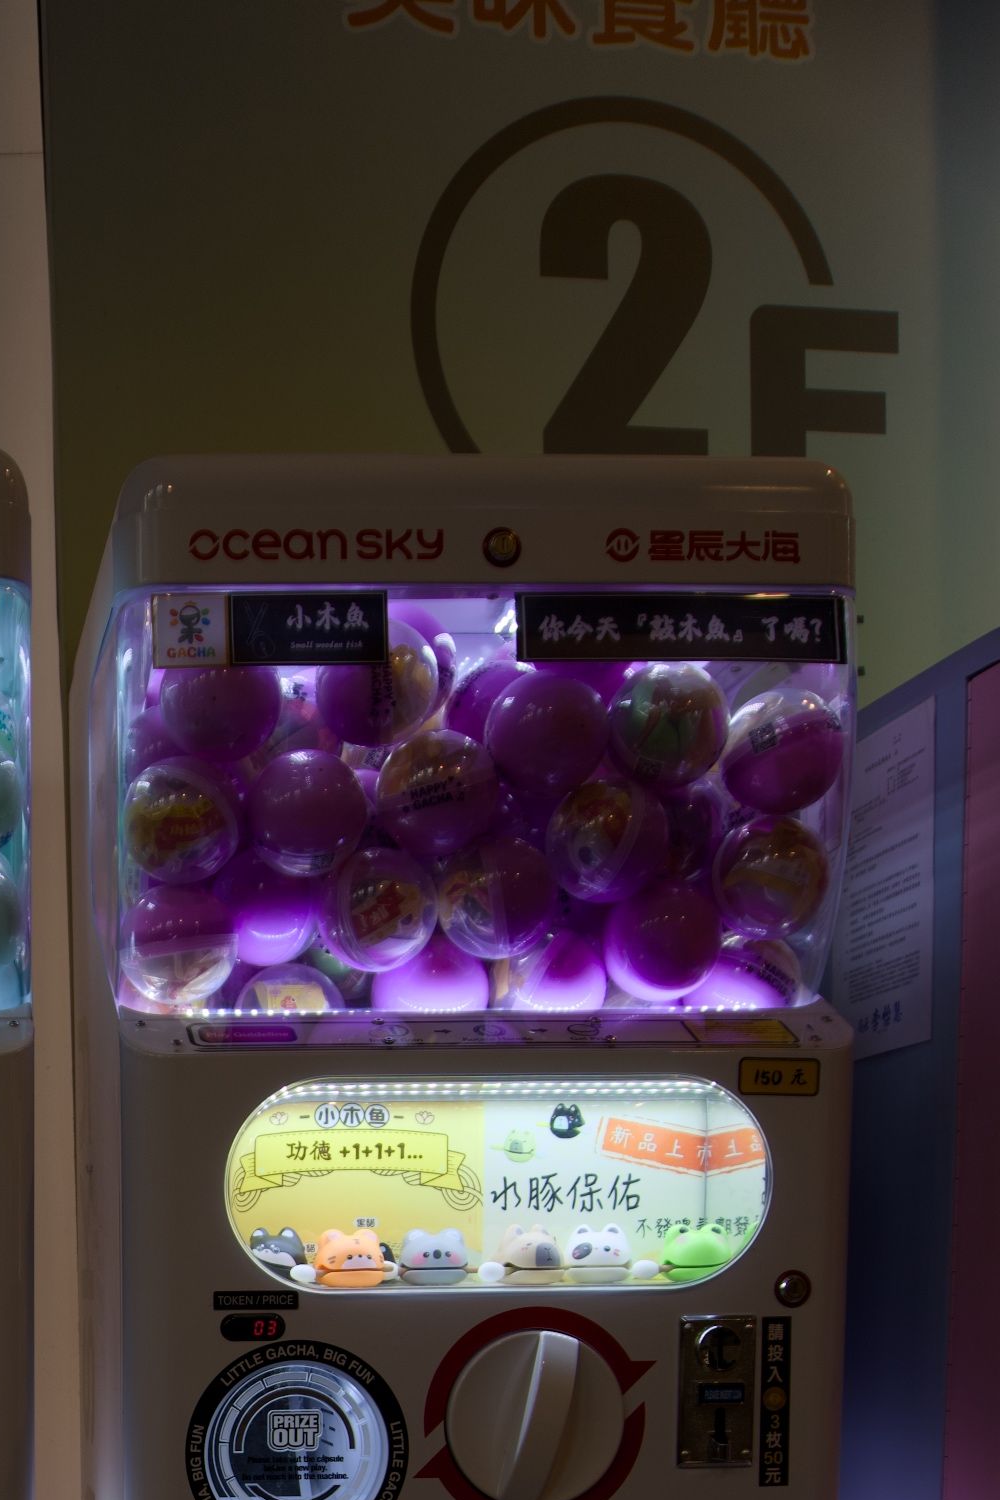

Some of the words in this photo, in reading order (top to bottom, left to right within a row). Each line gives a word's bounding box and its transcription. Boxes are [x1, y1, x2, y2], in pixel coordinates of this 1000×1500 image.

[540, 173, 899, 457] 2F
[648, 528, 801, 564] 星辰大海
[286, 602, 370, 630] 小木魚
[166, 647, 216, 658] GACHA
[411, 781, 447, 799] HAPPY
[413, 791, 454, 810] GACHA
[755, 1069, 782, 1086] 150
[790, 1068, 808, 1086] 元
[286, 1140, 332, 1161] 功德
[490, 1173, 641, 1213] 水豚保佑
[218, 1295, 254, 1306] TOKEN
[262, 1294, 294, 1305] PRICE
[252, 1318, 279, 1336] 03
[220, 1352, 264, 1386] LITTLE
[323, 1348, 346, 1366] BIG
[348, 1359, 375, 1385] FUN
[273, 1414, 319, 1428] PRIZE
[272, 1428, 318, 1448] OUT
